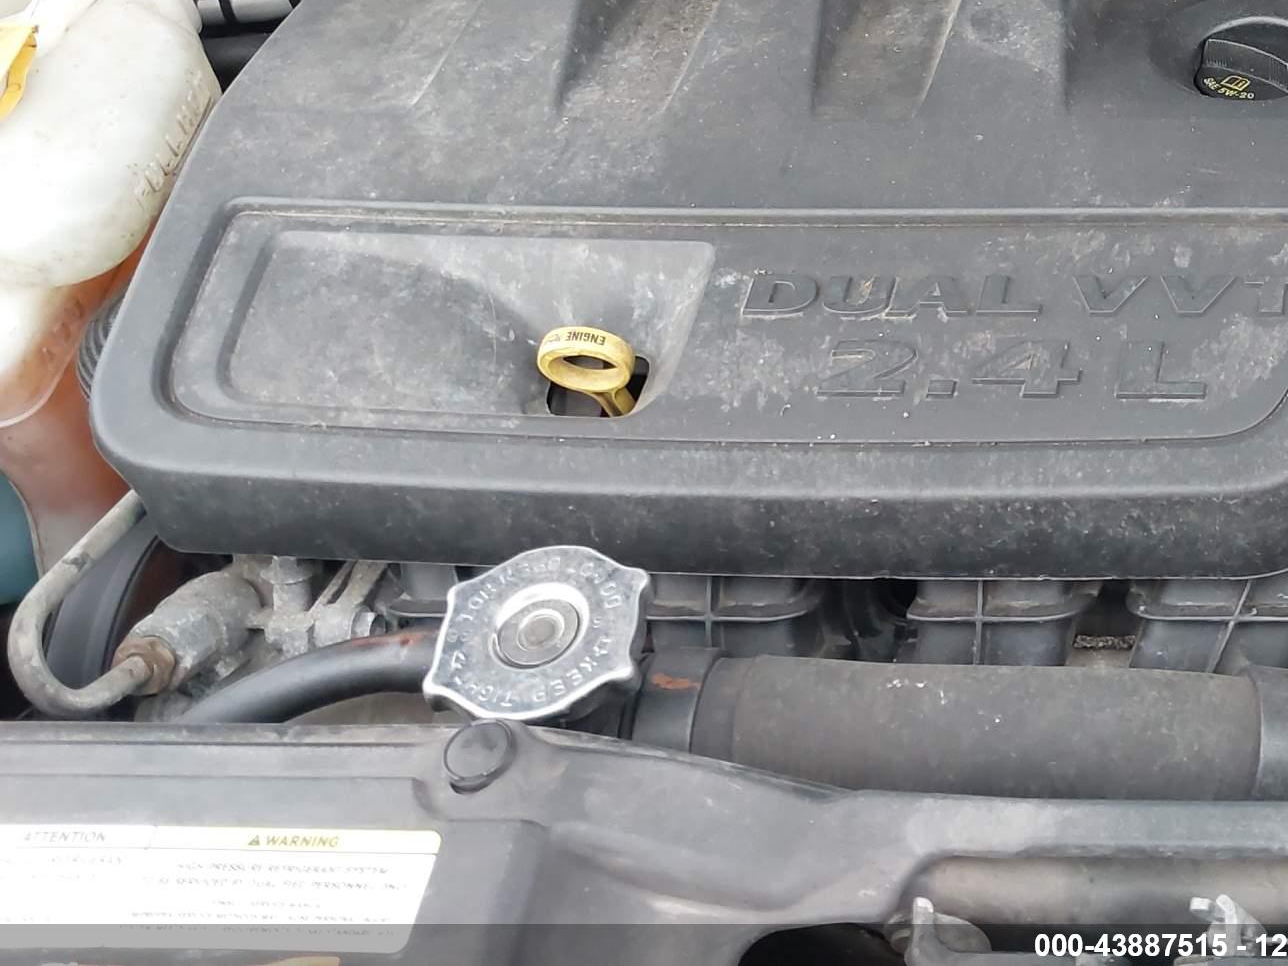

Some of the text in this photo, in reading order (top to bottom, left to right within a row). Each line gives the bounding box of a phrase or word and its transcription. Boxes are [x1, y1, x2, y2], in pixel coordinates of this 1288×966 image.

[1203, 77, 1255, 100] SAE 5W-20
[740, 274, 1042, 321] DUAL
[565, 331, 606, 346] ENGINE
[816, 339, 1207, 402] 2.4 L
[266, 835, 340, 849] WARNING
